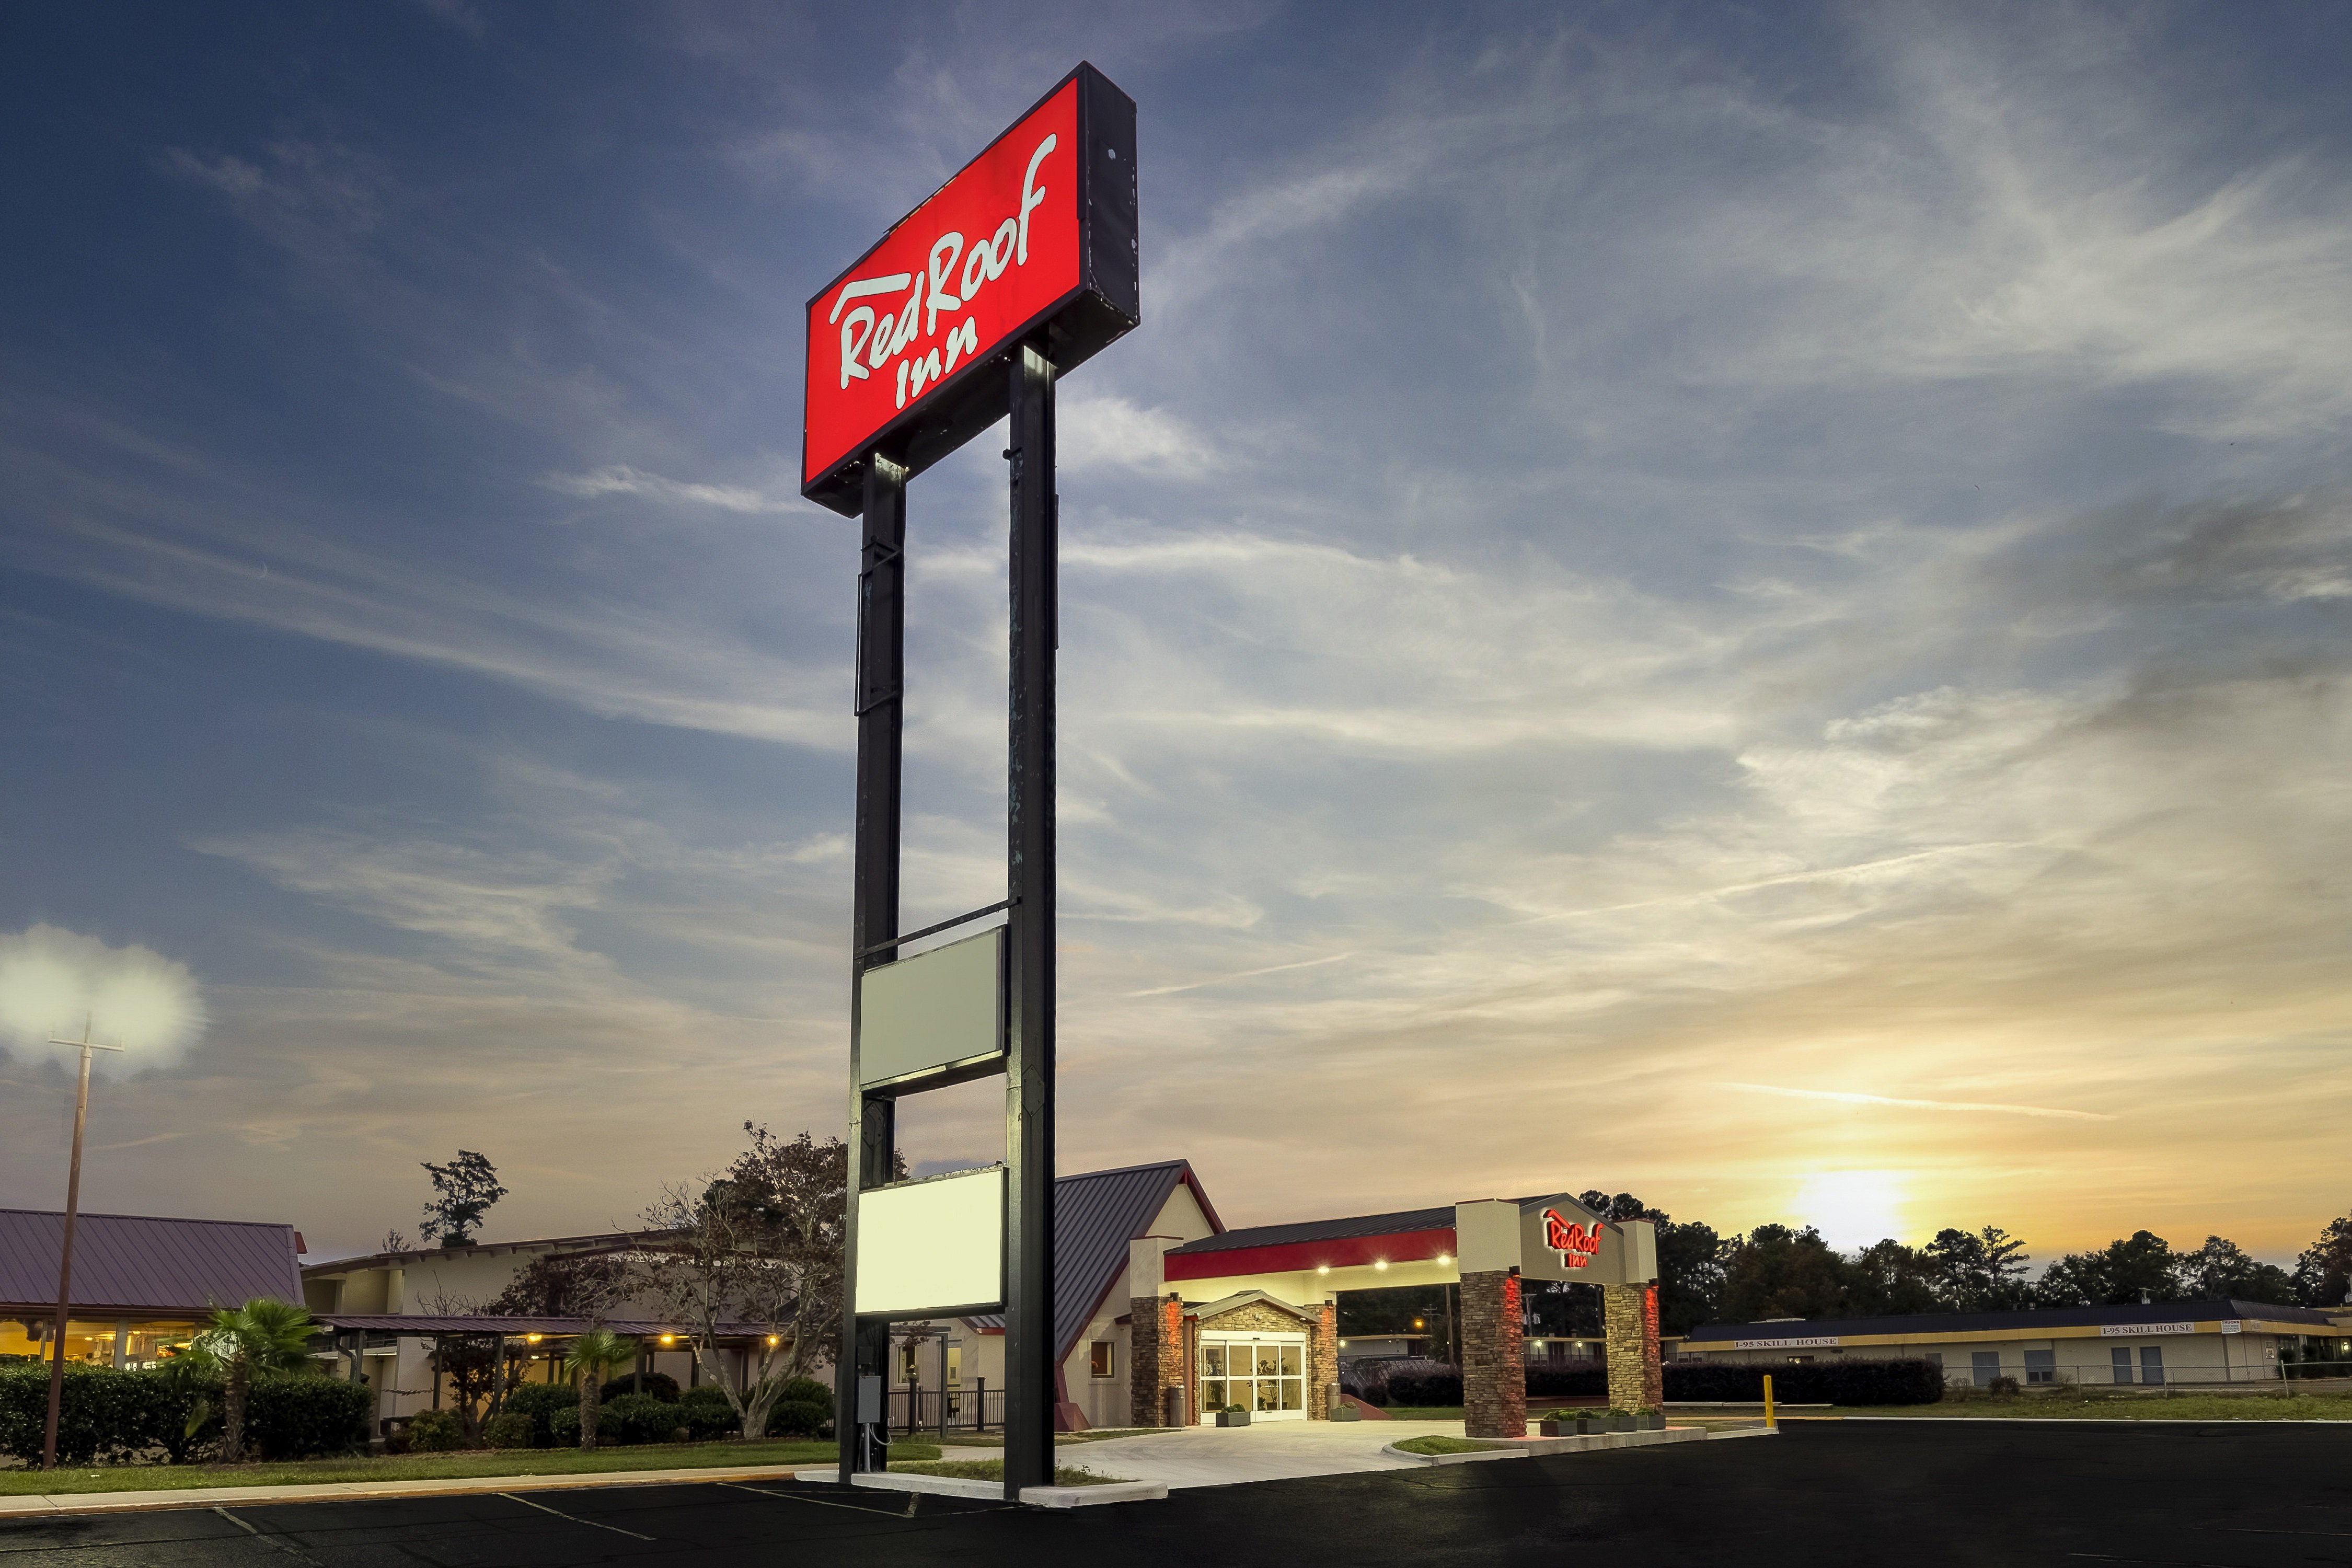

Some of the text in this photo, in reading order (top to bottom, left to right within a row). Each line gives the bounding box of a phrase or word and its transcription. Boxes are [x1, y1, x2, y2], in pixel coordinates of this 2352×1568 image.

[896, 316, 978, 409] Inn
[1568, 1253, 1587, 1267] Inn
[2156, 1324, 2192, 1332] HOUSE
